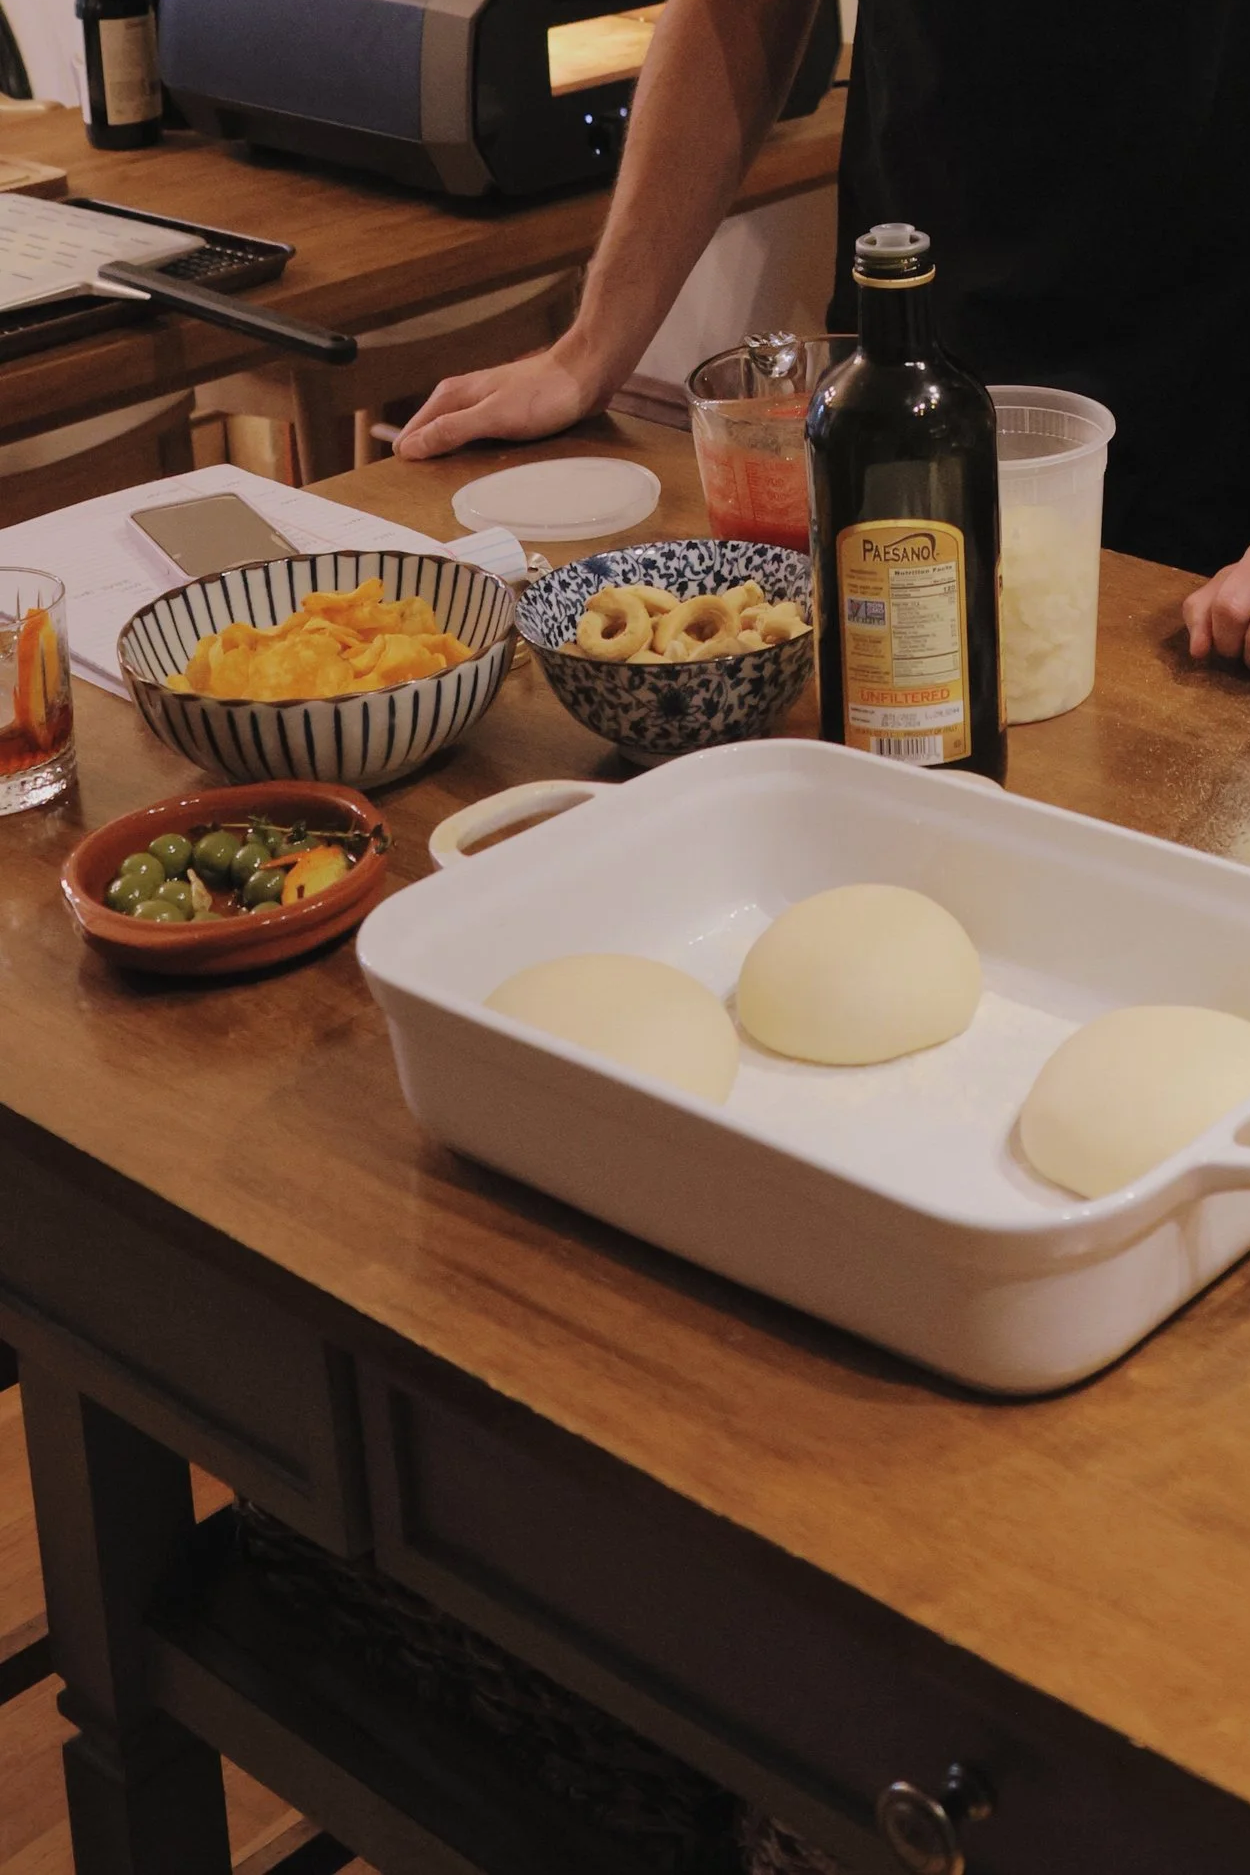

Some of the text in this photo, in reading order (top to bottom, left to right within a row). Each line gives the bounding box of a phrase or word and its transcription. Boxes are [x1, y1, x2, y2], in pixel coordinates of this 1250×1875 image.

[862, 535, 934, 562] PAESANO
[894, 568, 930, 576] Nutrition
[932, 565, 953, 574] Facts
[860, 689, 950, 704] UNFILTERED
